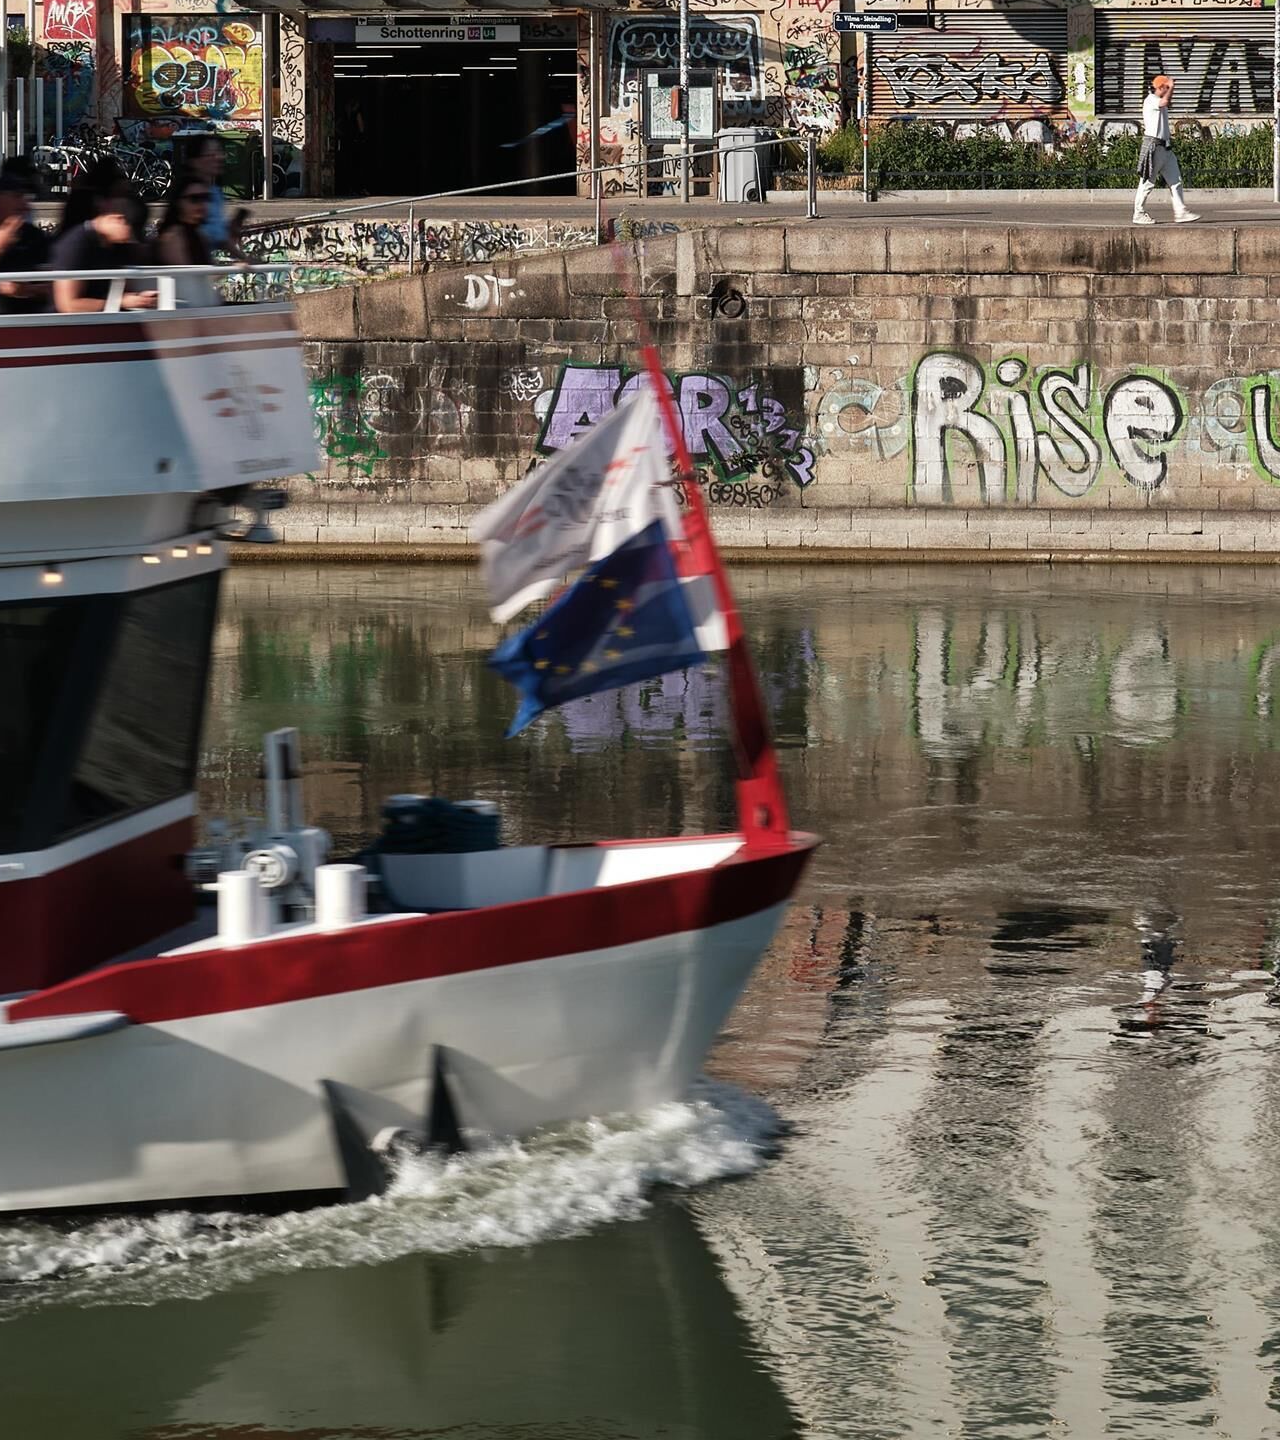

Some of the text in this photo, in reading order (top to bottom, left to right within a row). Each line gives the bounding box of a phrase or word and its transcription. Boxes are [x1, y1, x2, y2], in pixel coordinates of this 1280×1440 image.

[849, 22, 881, 30] Promenade
[380, 27, 495, 41] Schottenring U2 U4
